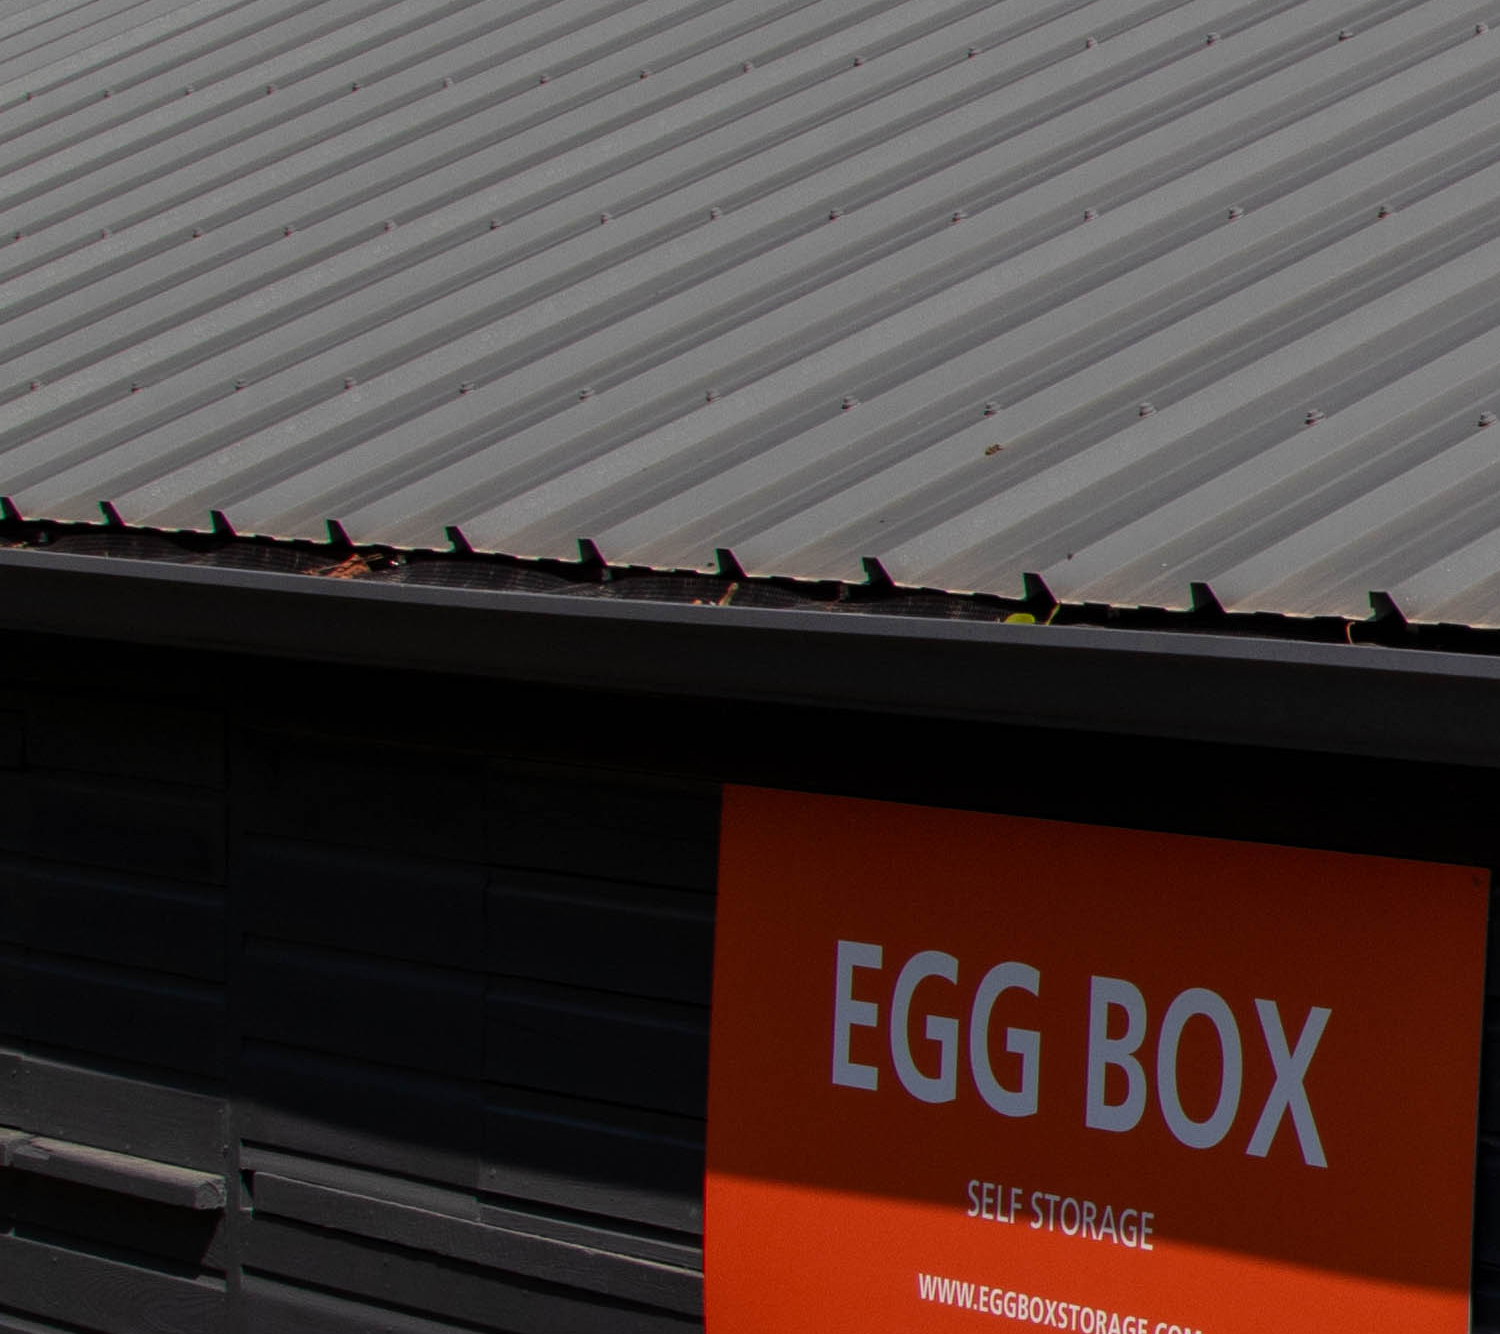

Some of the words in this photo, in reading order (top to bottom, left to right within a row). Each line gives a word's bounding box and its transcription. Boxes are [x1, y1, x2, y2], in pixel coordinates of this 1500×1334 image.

[831, 940, 1041, 1118] EGG
[1084, 975, 1332, 1168] BOX
[966, 1179, 1023, 1225] SELF
[1029, 1191, 1155, 1252] STORAGE
